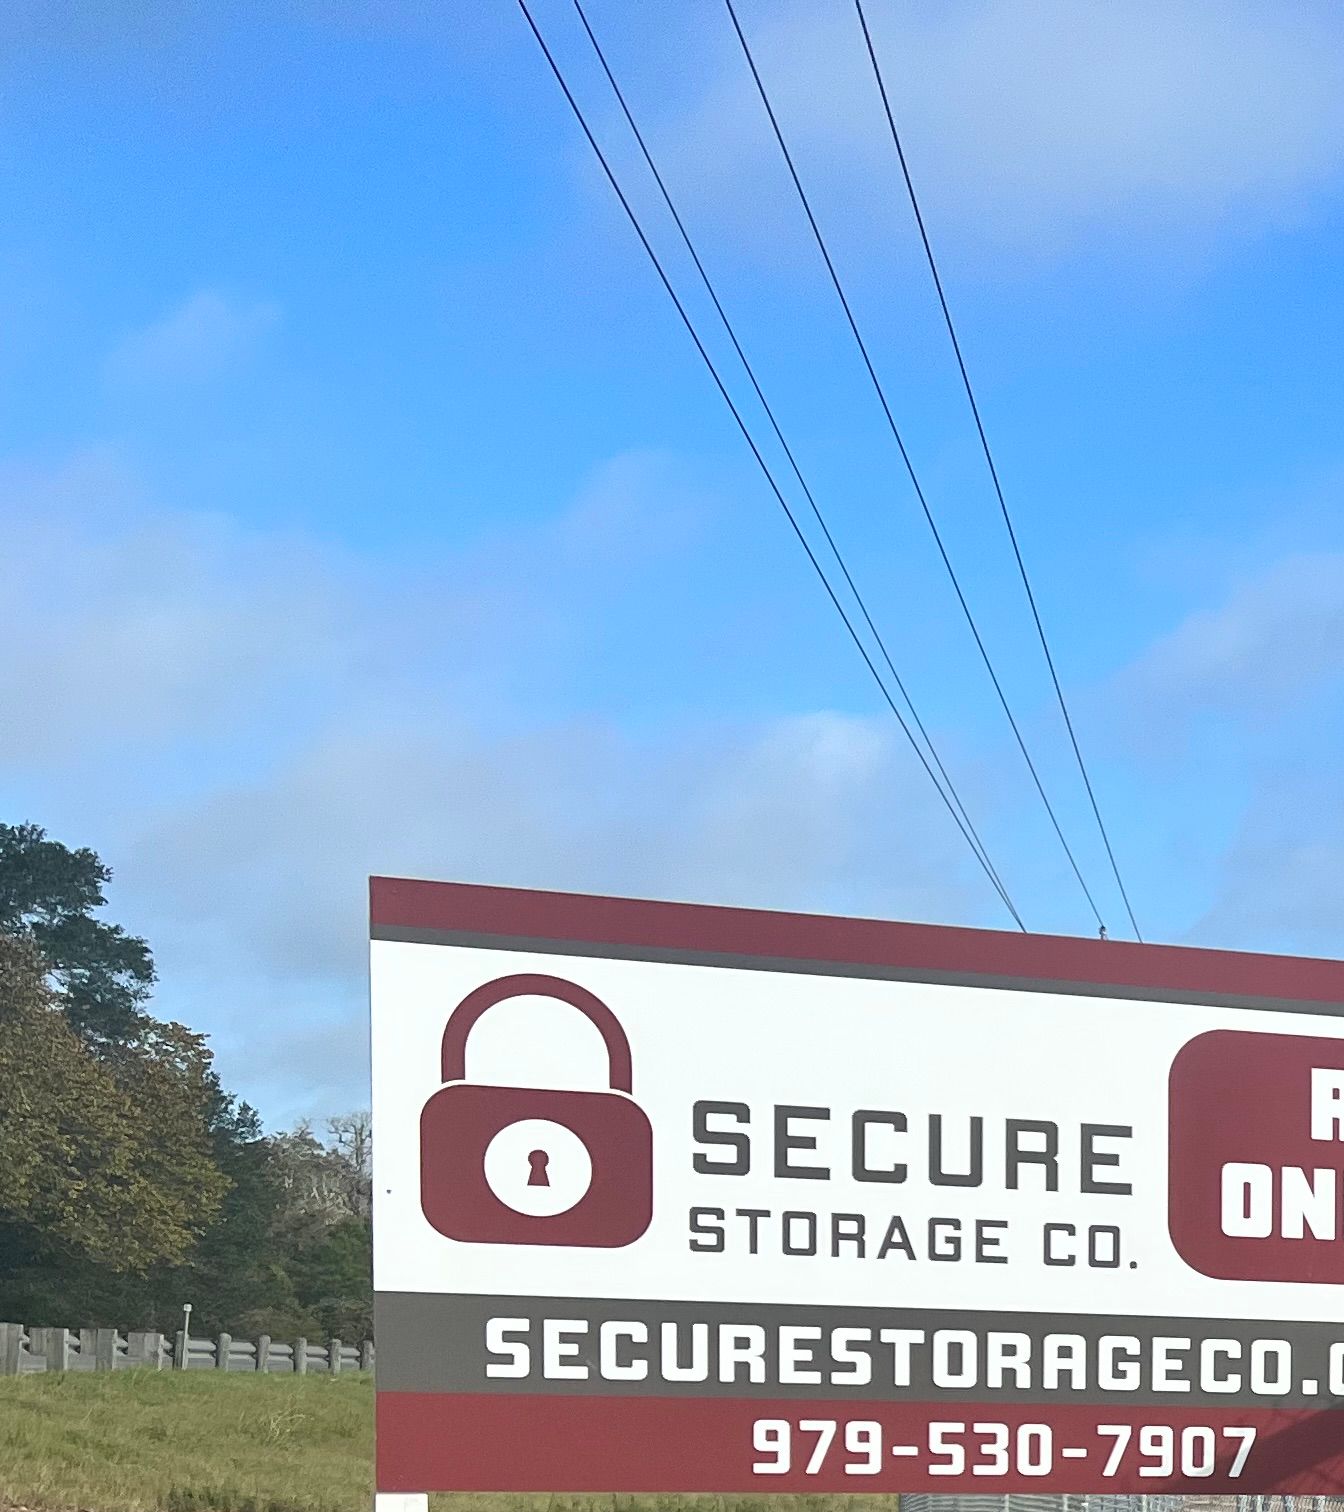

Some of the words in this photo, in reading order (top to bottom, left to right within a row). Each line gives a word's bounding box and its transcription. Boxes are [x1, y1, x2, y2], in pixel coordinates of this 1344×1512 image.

[691, 1098, 1134, 1197] SECURE
[687, 1205, 1010, 1266] STORAGE
[1042, 1221, 1139, 1271] CO.
[751, 1418, 1258, 1479] 979-530-7907
